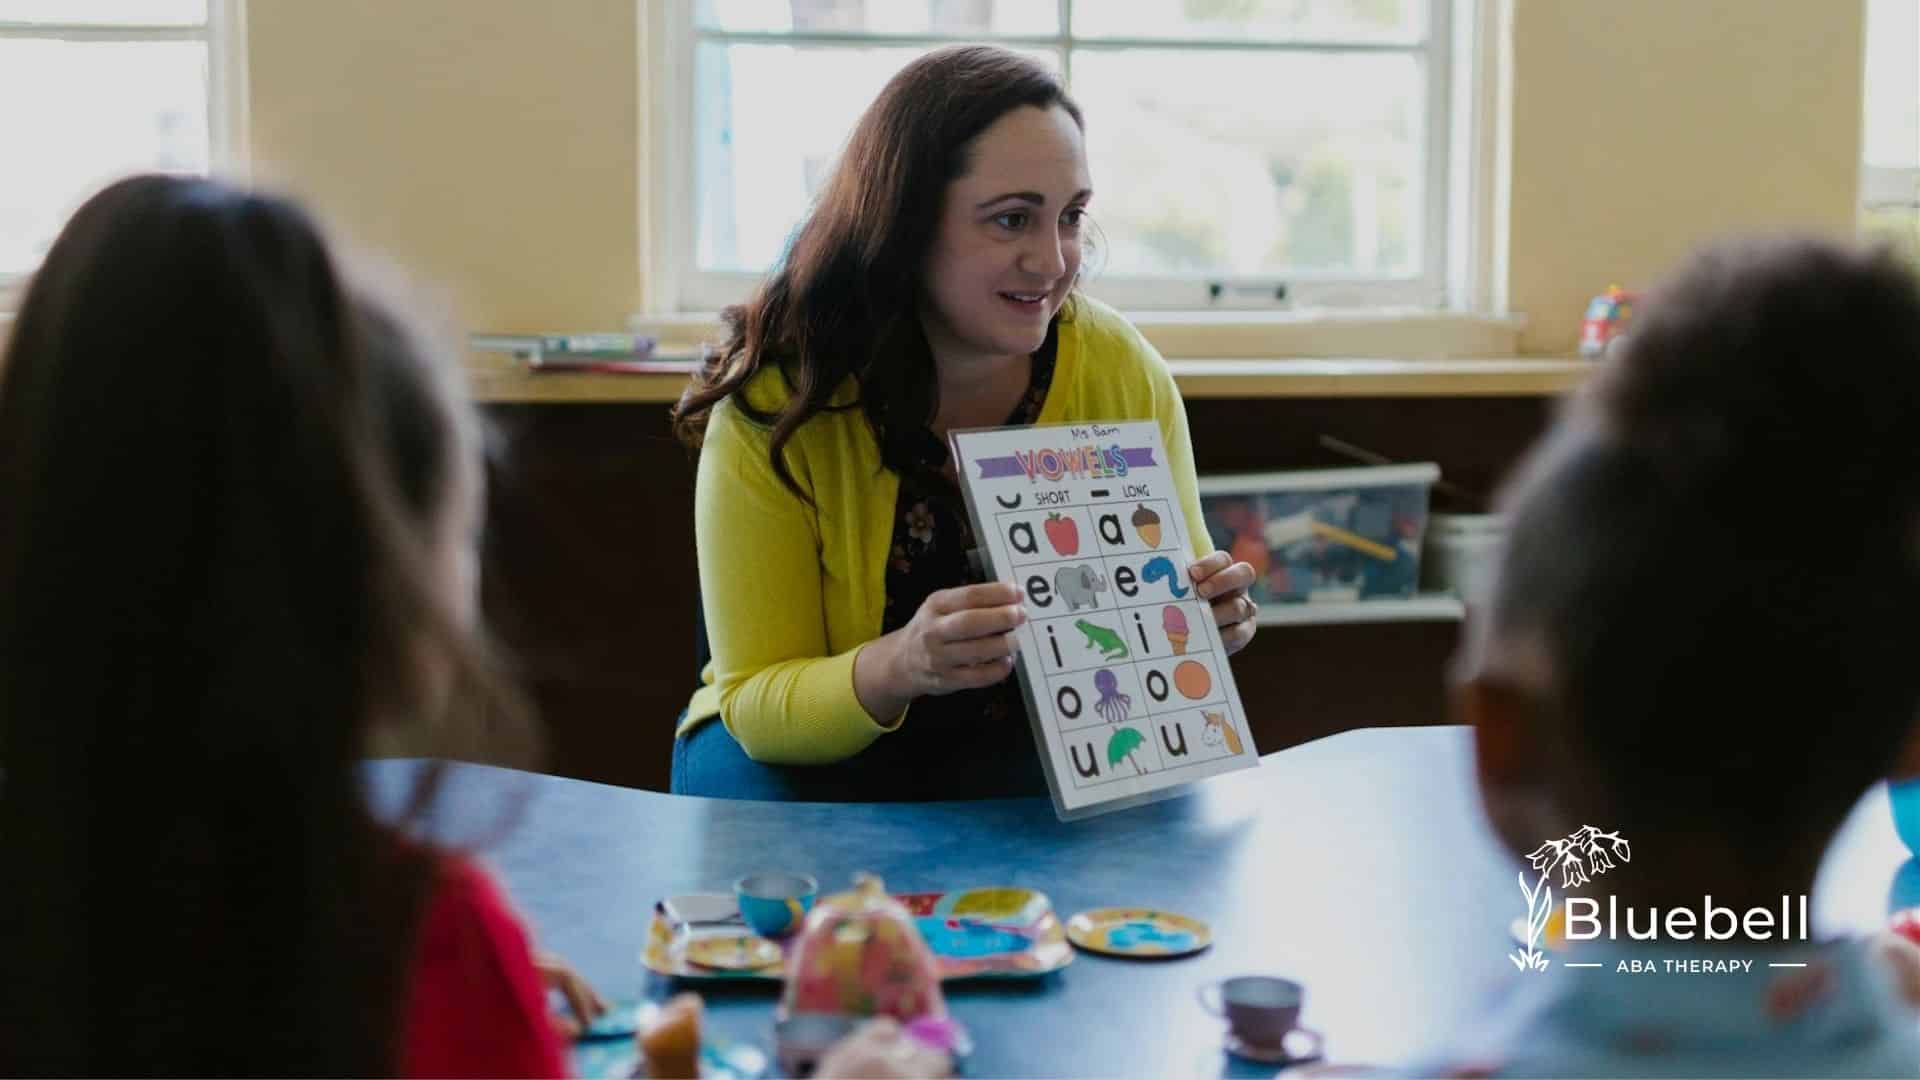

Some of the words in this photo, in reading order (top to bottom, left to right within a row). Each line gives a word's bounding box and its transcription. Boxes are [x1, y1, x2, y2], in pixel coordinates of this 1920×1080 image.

[1015, 445, 1129, 481] VOWELS
[1035, 489, 1071, 505] SHORT
[1122, 485, 1151, 498] LONG
[1008, 520, 1040, 555] a
[1099, 512, 1126, 546] a
[1025, 575, 1054, 608] e
[1114, 565, 1139, 597] e
[1046, 624, 1063, 668] i
[1133, 612, 1150, 654] i
[1056, 685, 1083, 720] o
[1145, 669, 1170, 702] o
[1160, 722, 1189, 757] u
[1070, 741, 1100, 778] u
